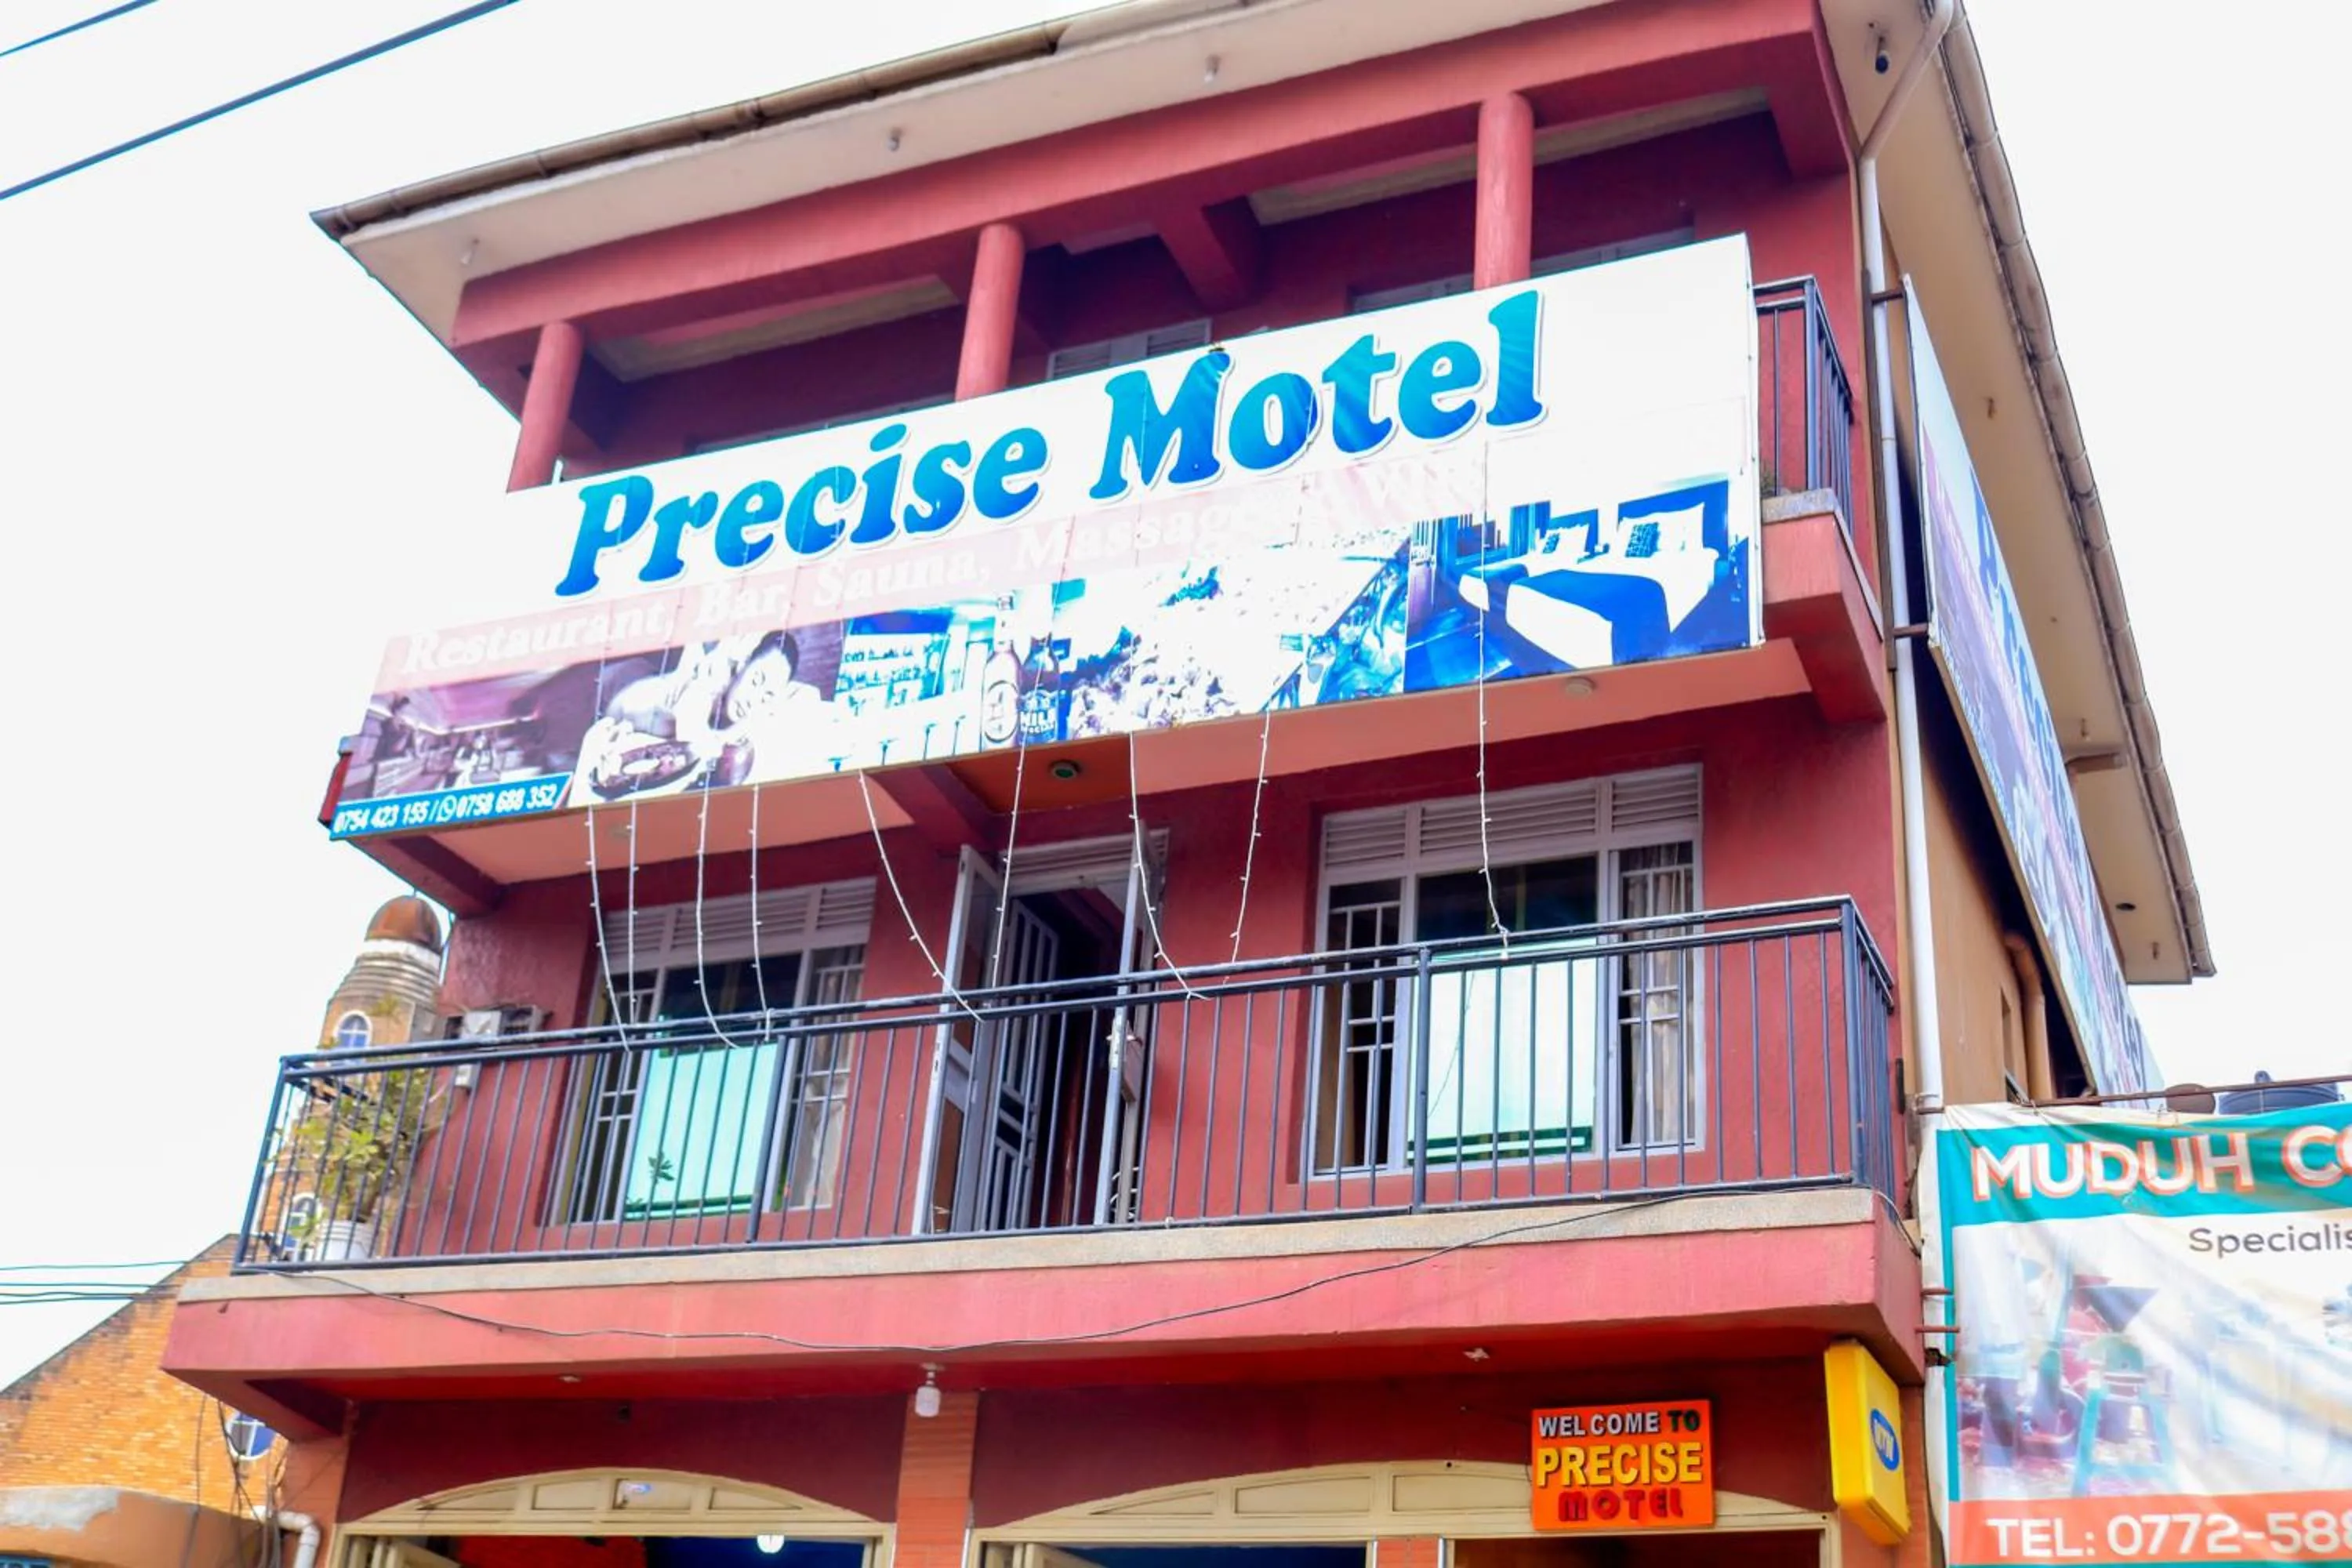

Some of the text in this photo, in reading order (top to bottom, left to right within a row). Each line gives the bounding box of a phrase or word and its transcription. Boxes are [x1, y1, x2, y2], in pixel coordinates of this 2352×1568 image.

[554, 423, 1049, 597] Precise
[1088, 289, 1544, 499] Motel
[371, 804, 399, 827] 423
[402, 800, 430, 824] 155
[1971, 1124, 2352, 1201] MUDUH C
[1667, 1409, 1701, 1432] TO
[1536, 1442, 1704, 1487] PRECISE
[1558, 1488, 1684, 1523] MOTEL
[1986, 1508, 2352, 1557] TEL: 0772-58
